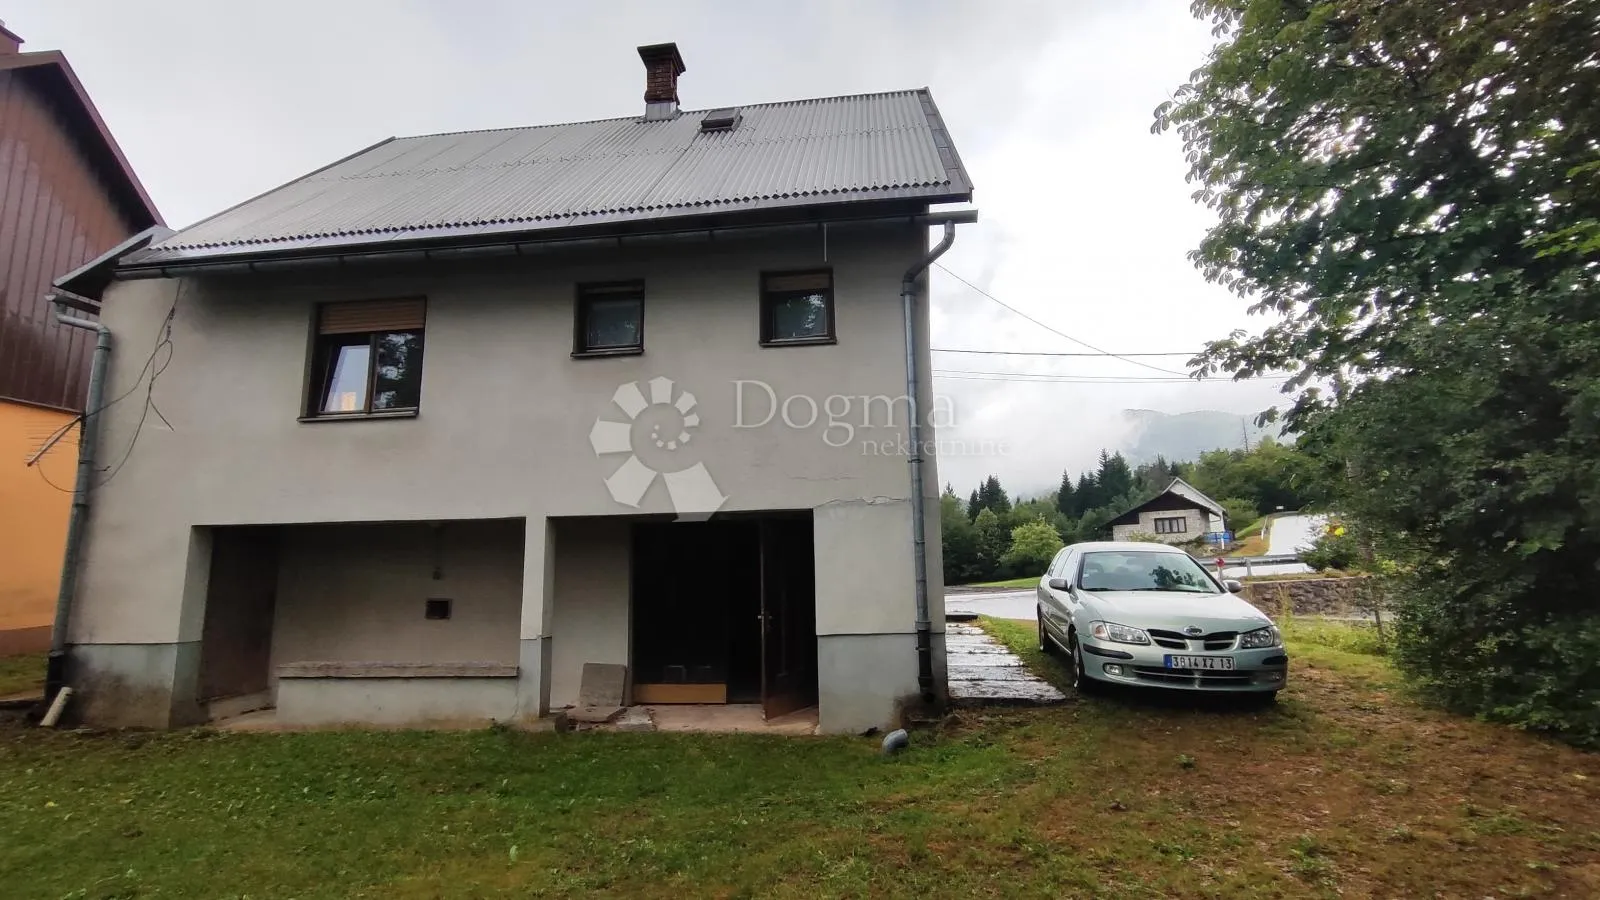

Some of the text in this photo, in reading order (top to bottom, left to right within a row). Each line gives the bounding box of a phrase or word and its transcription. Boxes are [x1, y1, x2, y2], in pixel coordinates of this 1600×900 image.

[1173, 656, 1199, 668] 3814
[1202, 657, 1214, 669] XZ
[1220, 658, 1232, 670] 13
